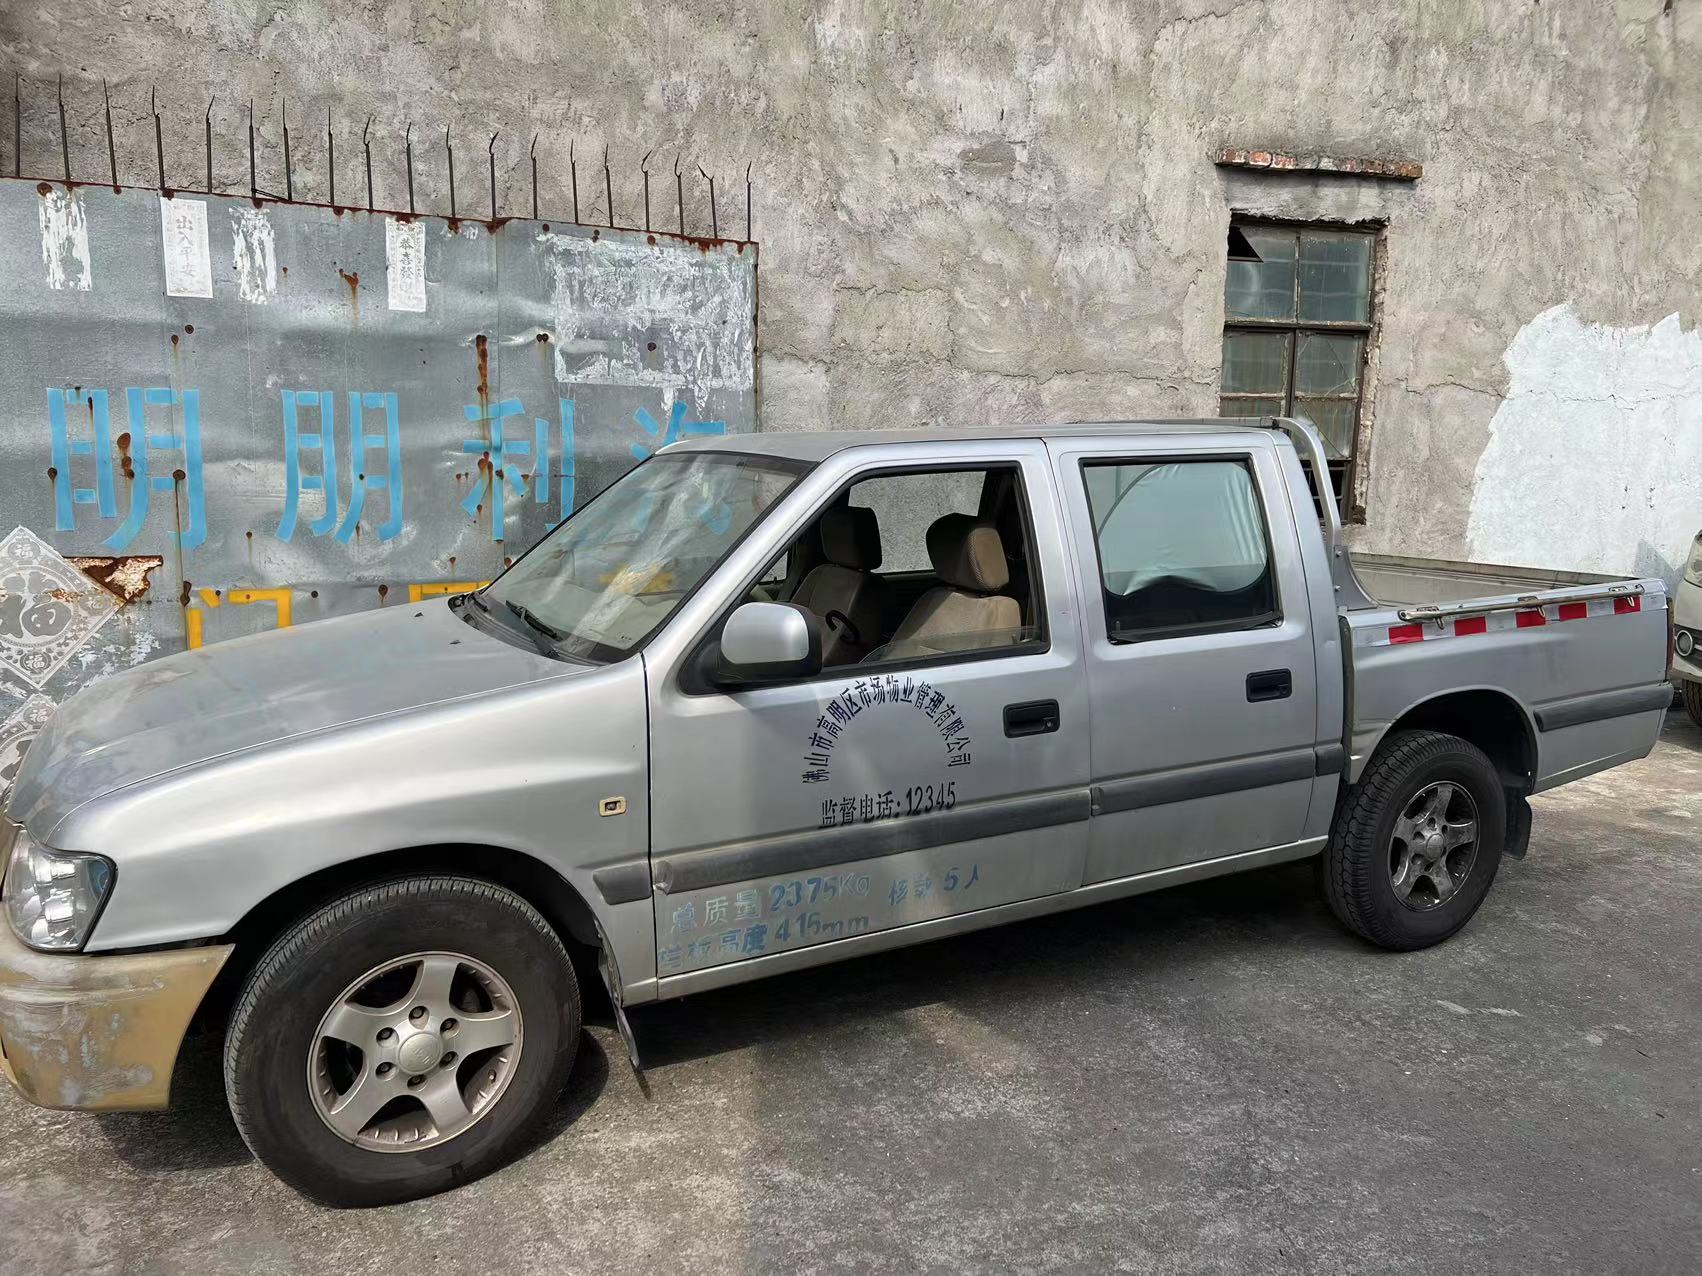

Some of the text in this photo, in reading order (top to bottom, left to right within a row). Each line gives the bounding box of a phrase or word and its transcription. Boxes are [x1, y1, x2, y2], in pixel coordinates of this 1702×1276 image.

[175, 215, 197, 278] 出入平安
[801, 674, 972, 784] 佛山市高明区市场物业管理有限公司
